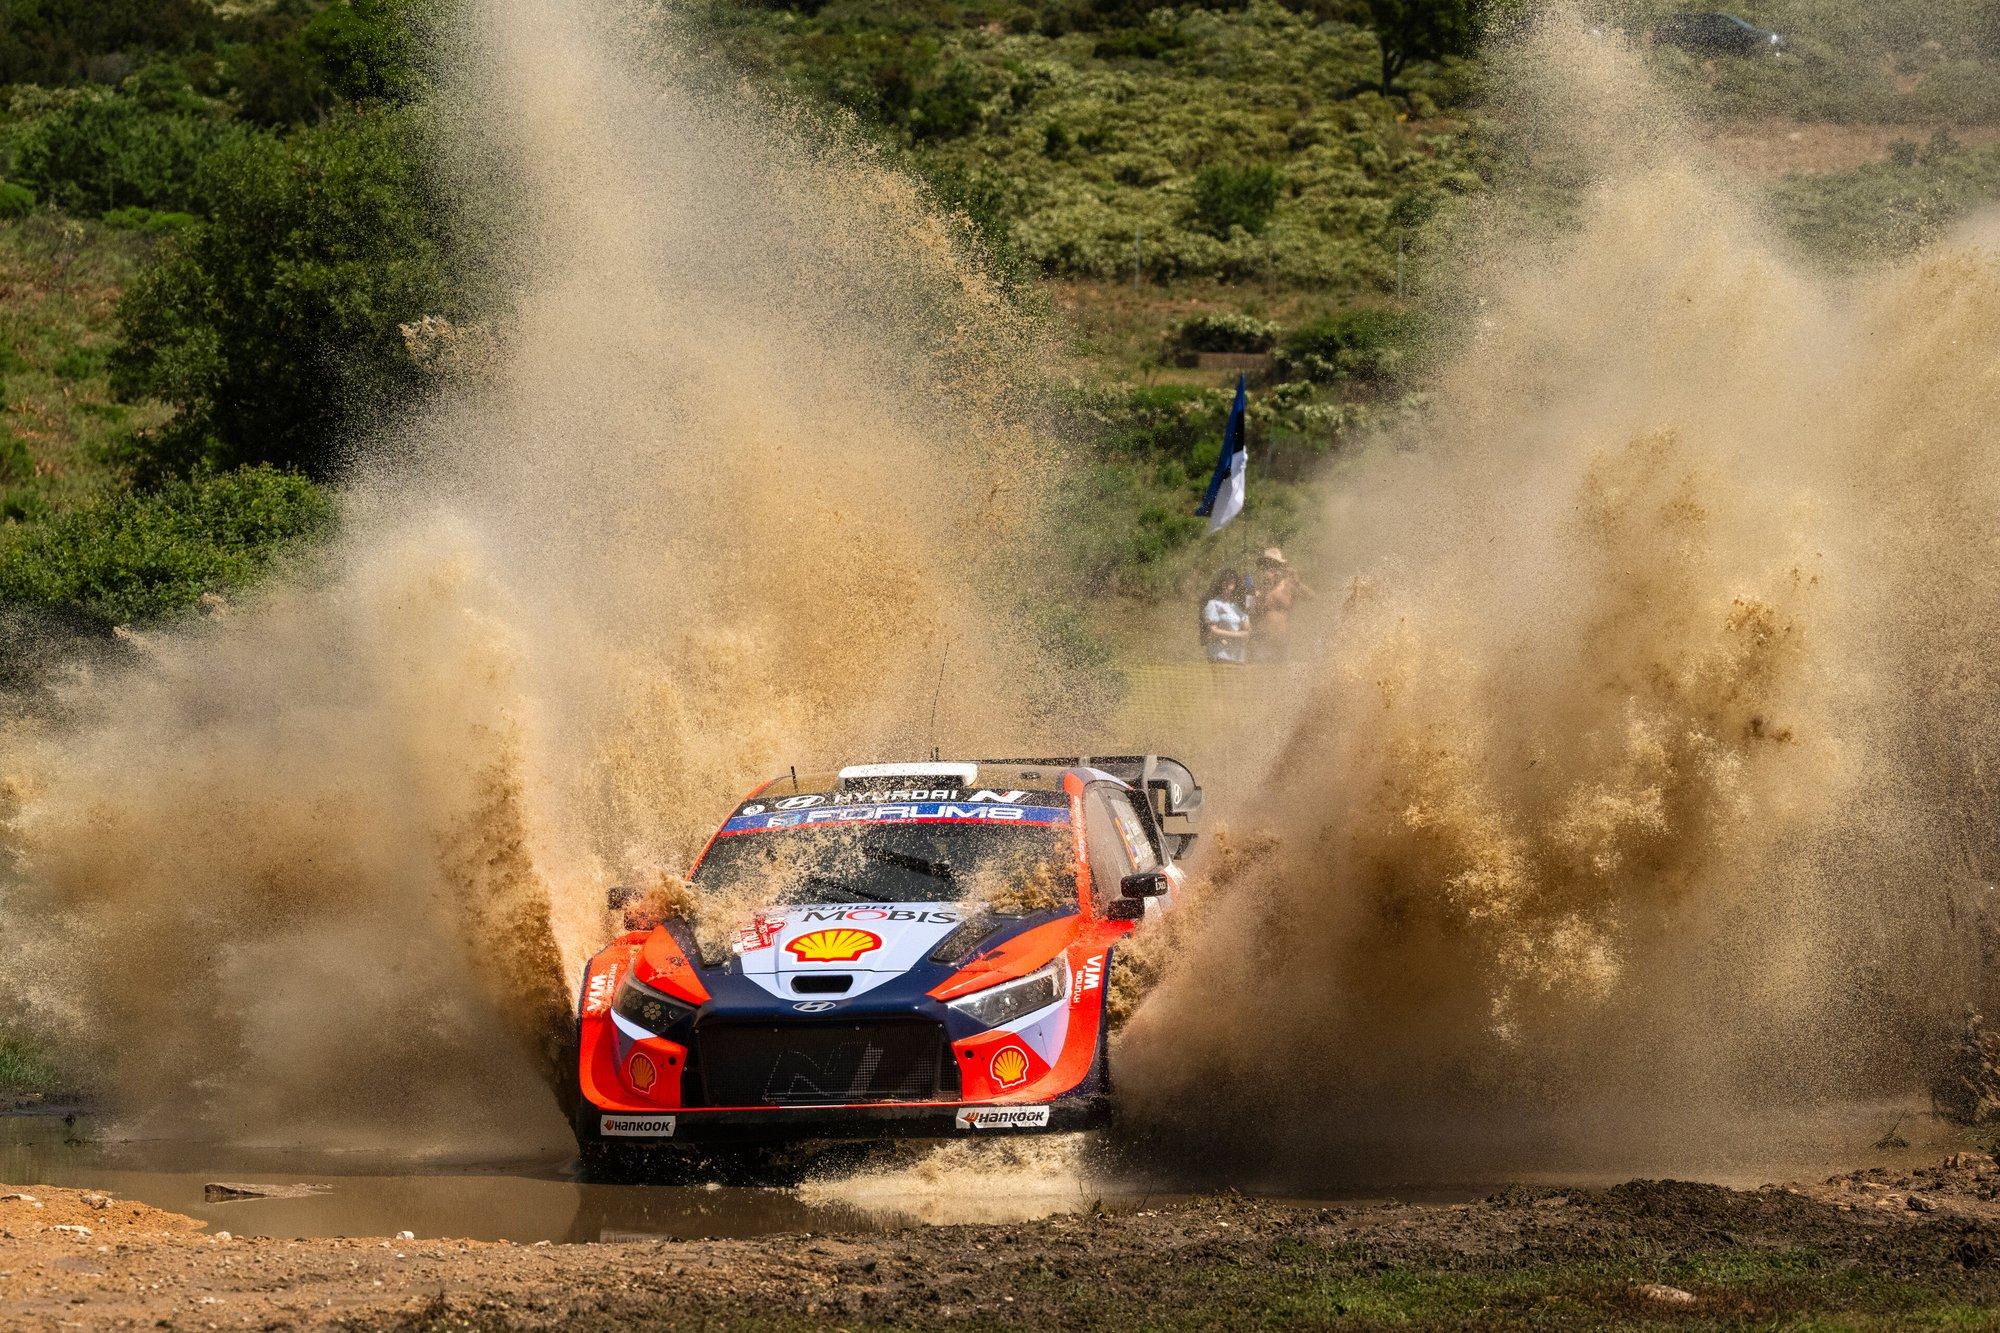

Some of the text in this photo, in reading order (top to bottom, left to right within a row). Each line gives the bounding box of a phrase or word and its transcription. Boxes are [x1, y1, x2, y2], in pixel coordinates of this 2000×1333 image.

[806, 804, 1024, 823] FORUM8
[801, 909, 957, 924] MOBIS
[1073, 970, 1084, 1003] HYUNDAI
